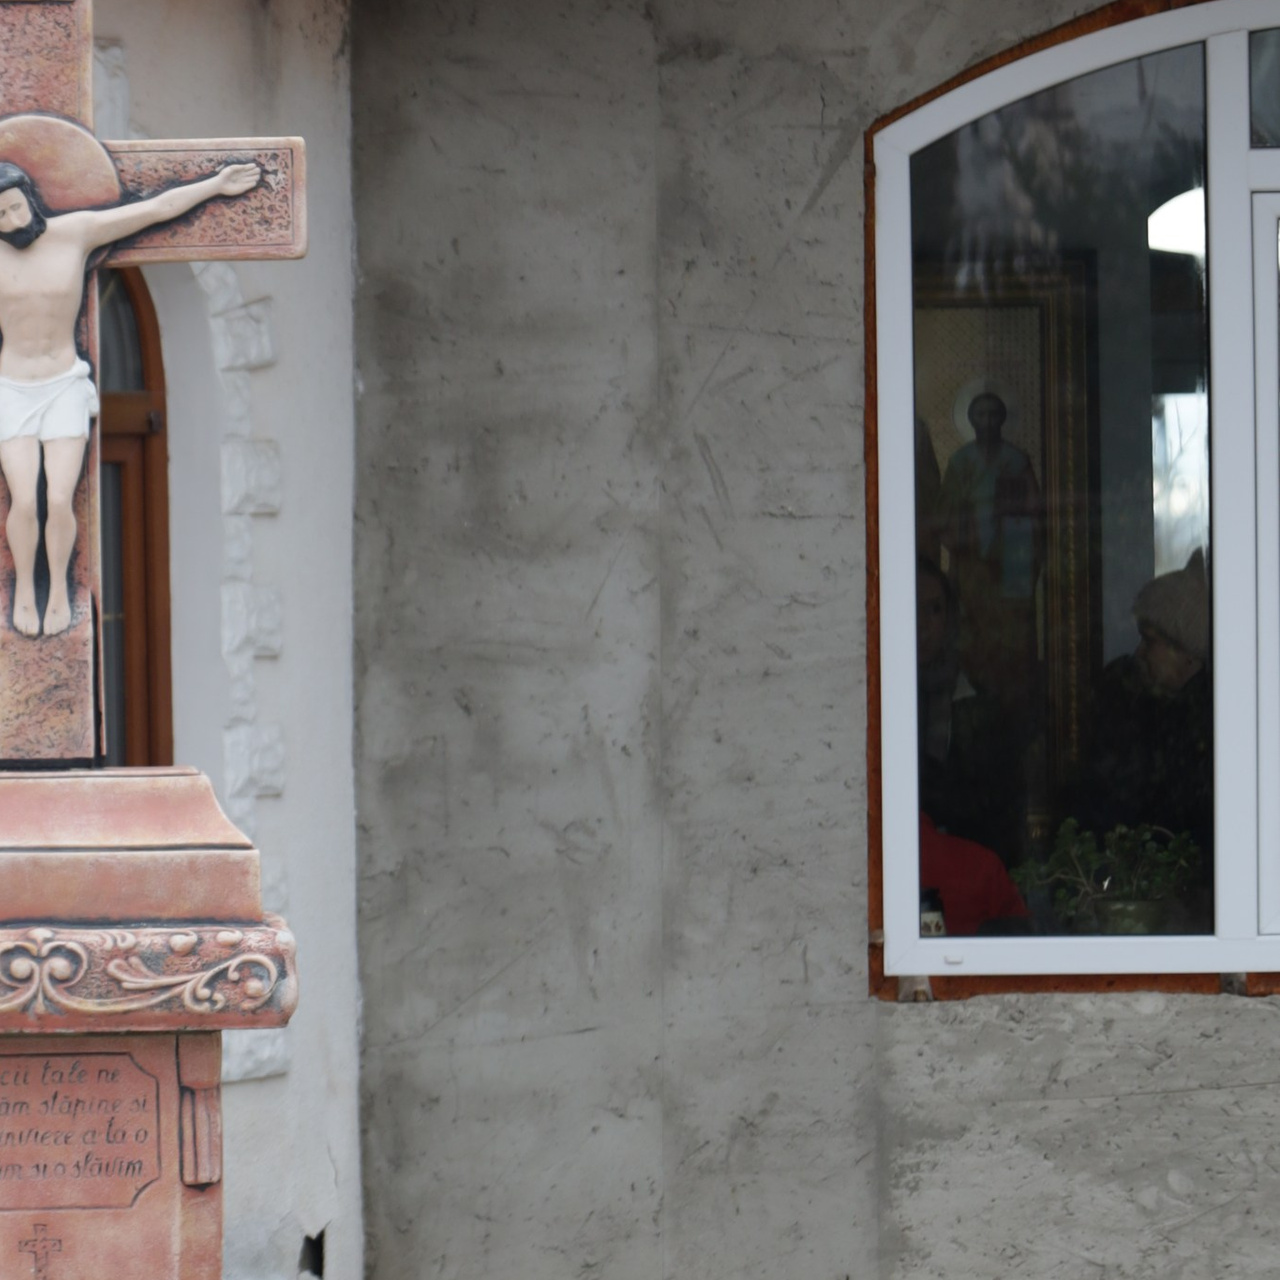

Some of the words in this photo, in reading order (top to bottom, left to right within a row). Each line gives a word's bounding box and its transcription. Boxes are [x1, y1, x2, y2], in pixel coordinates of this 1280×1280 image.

[41, 1059, 89, 1086] tale
[96, 1068, 122, 1084] ne
[81, 1129, 97, 1146] a
[133, 1128, 149, 1145] o
[53, 1161, 66, 1177] o
